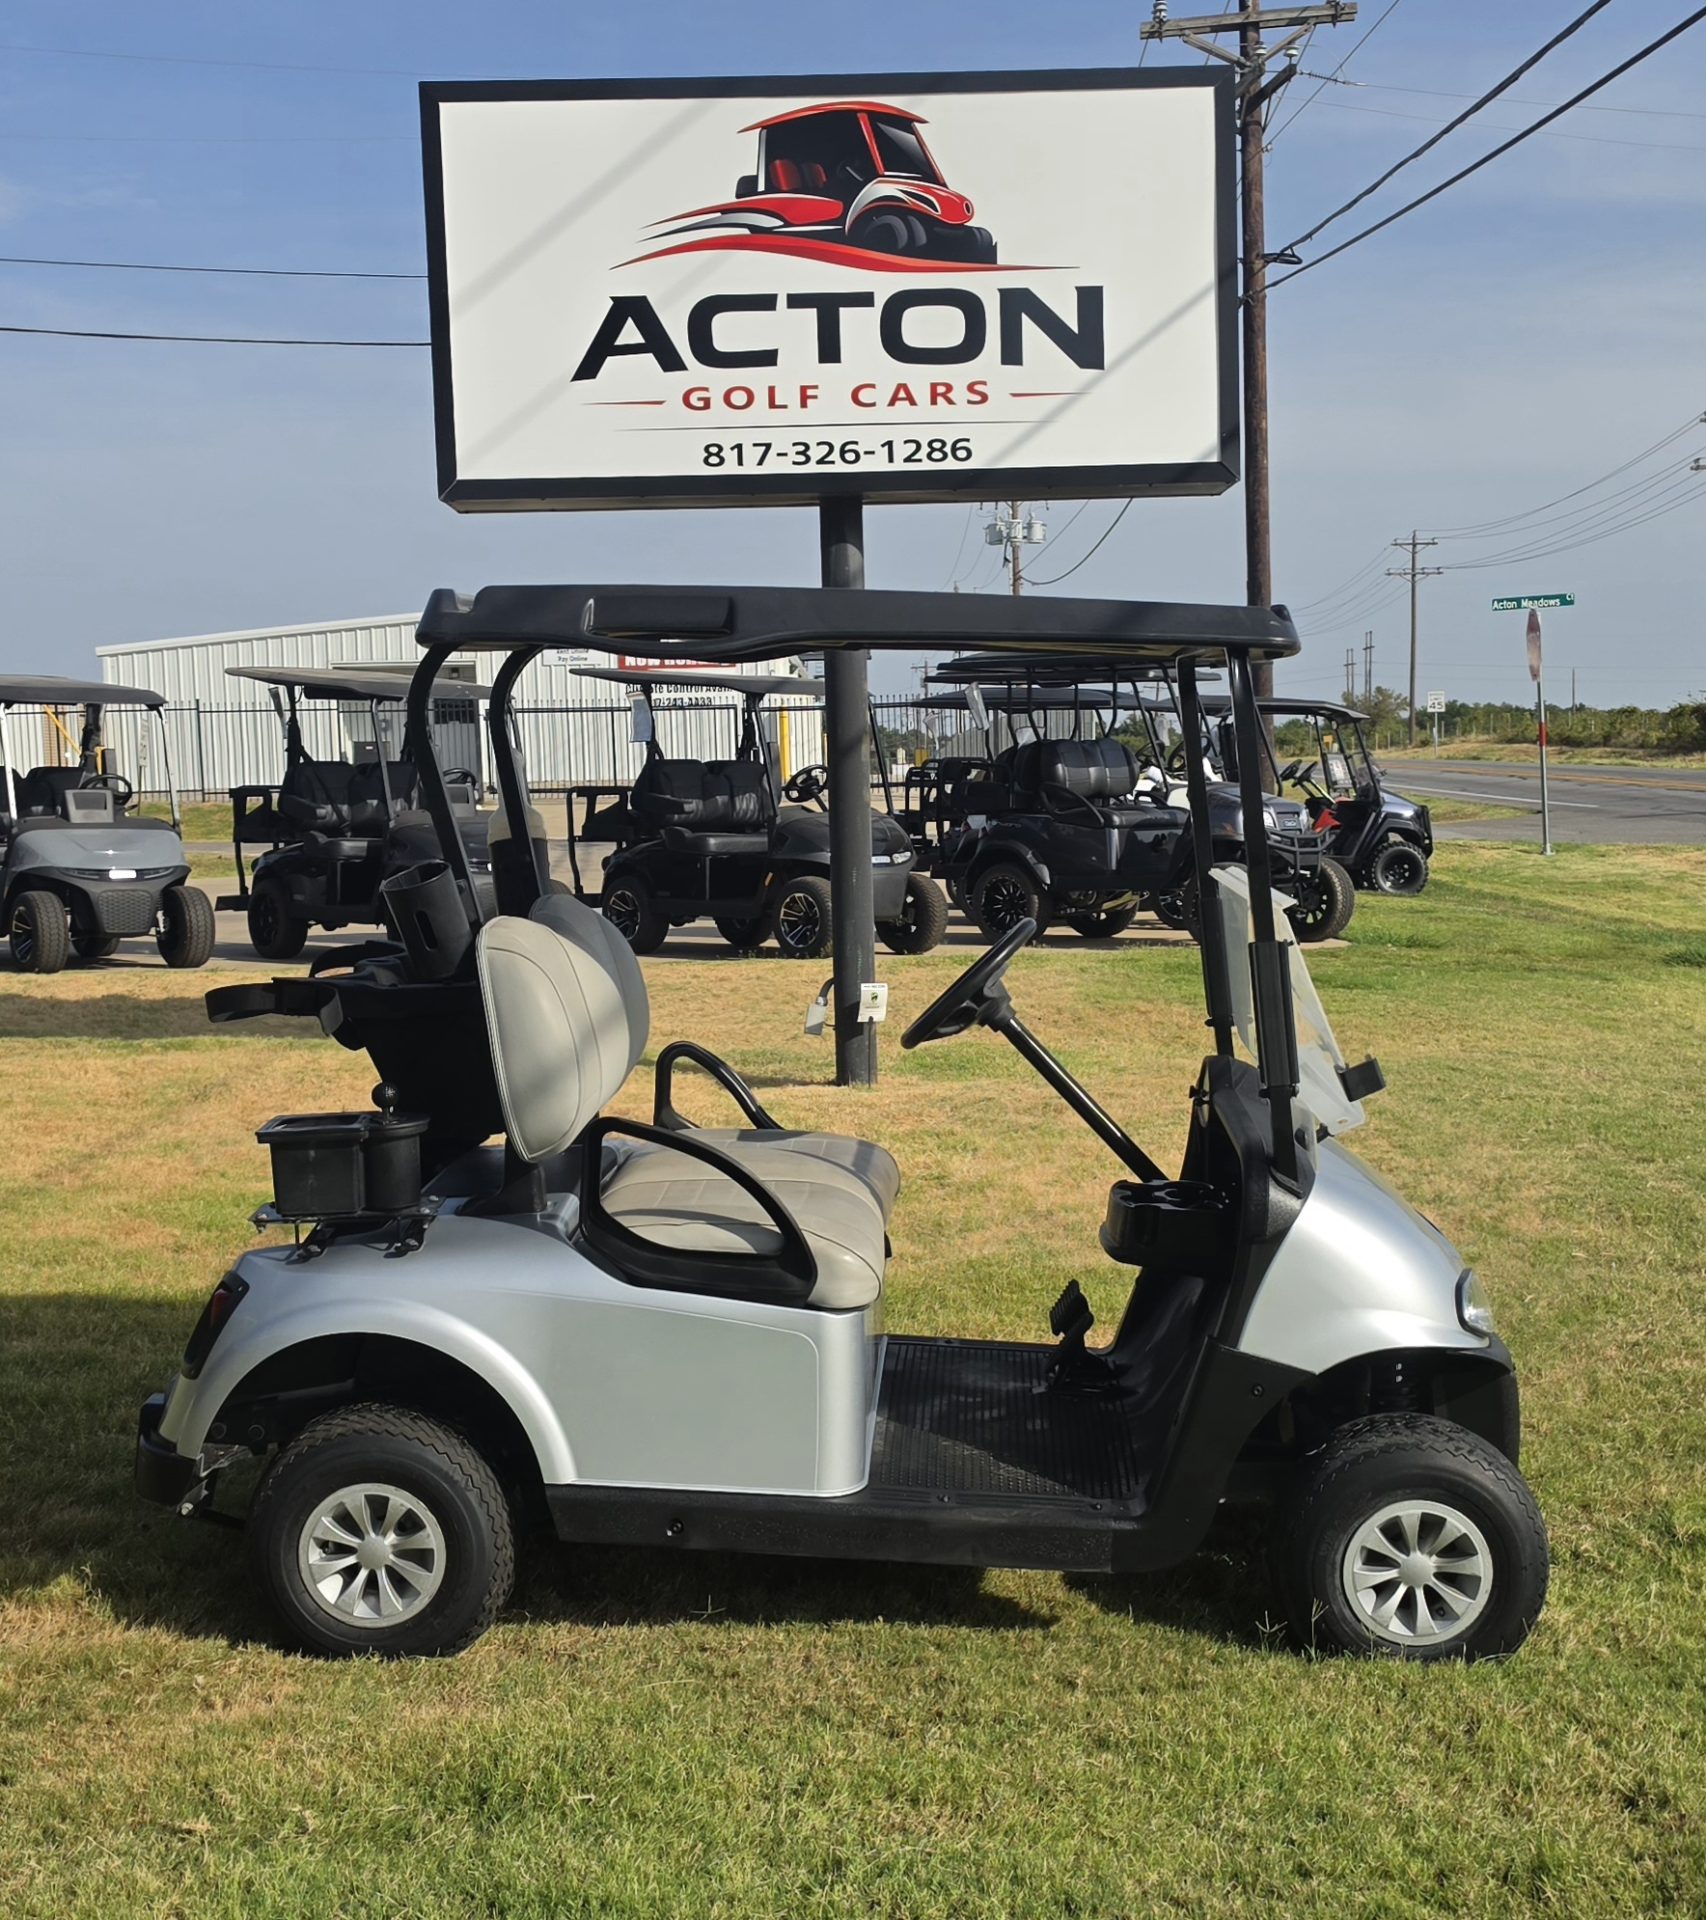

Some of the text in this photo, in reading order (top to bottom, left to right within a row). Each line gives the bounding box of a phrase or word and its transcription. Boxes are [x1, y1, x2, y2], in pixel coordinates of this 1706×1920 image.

[570, 285, 1105, 381] ACTON
[682, 380, 990, 412] GOLF CARS
[702, 438, 973, 468] 817-326-1286
[1493, 600, 1517, 609] Acton
[1521, 598, 1560, 608] Meadows
[1429, 701, 1444, 710] 45
